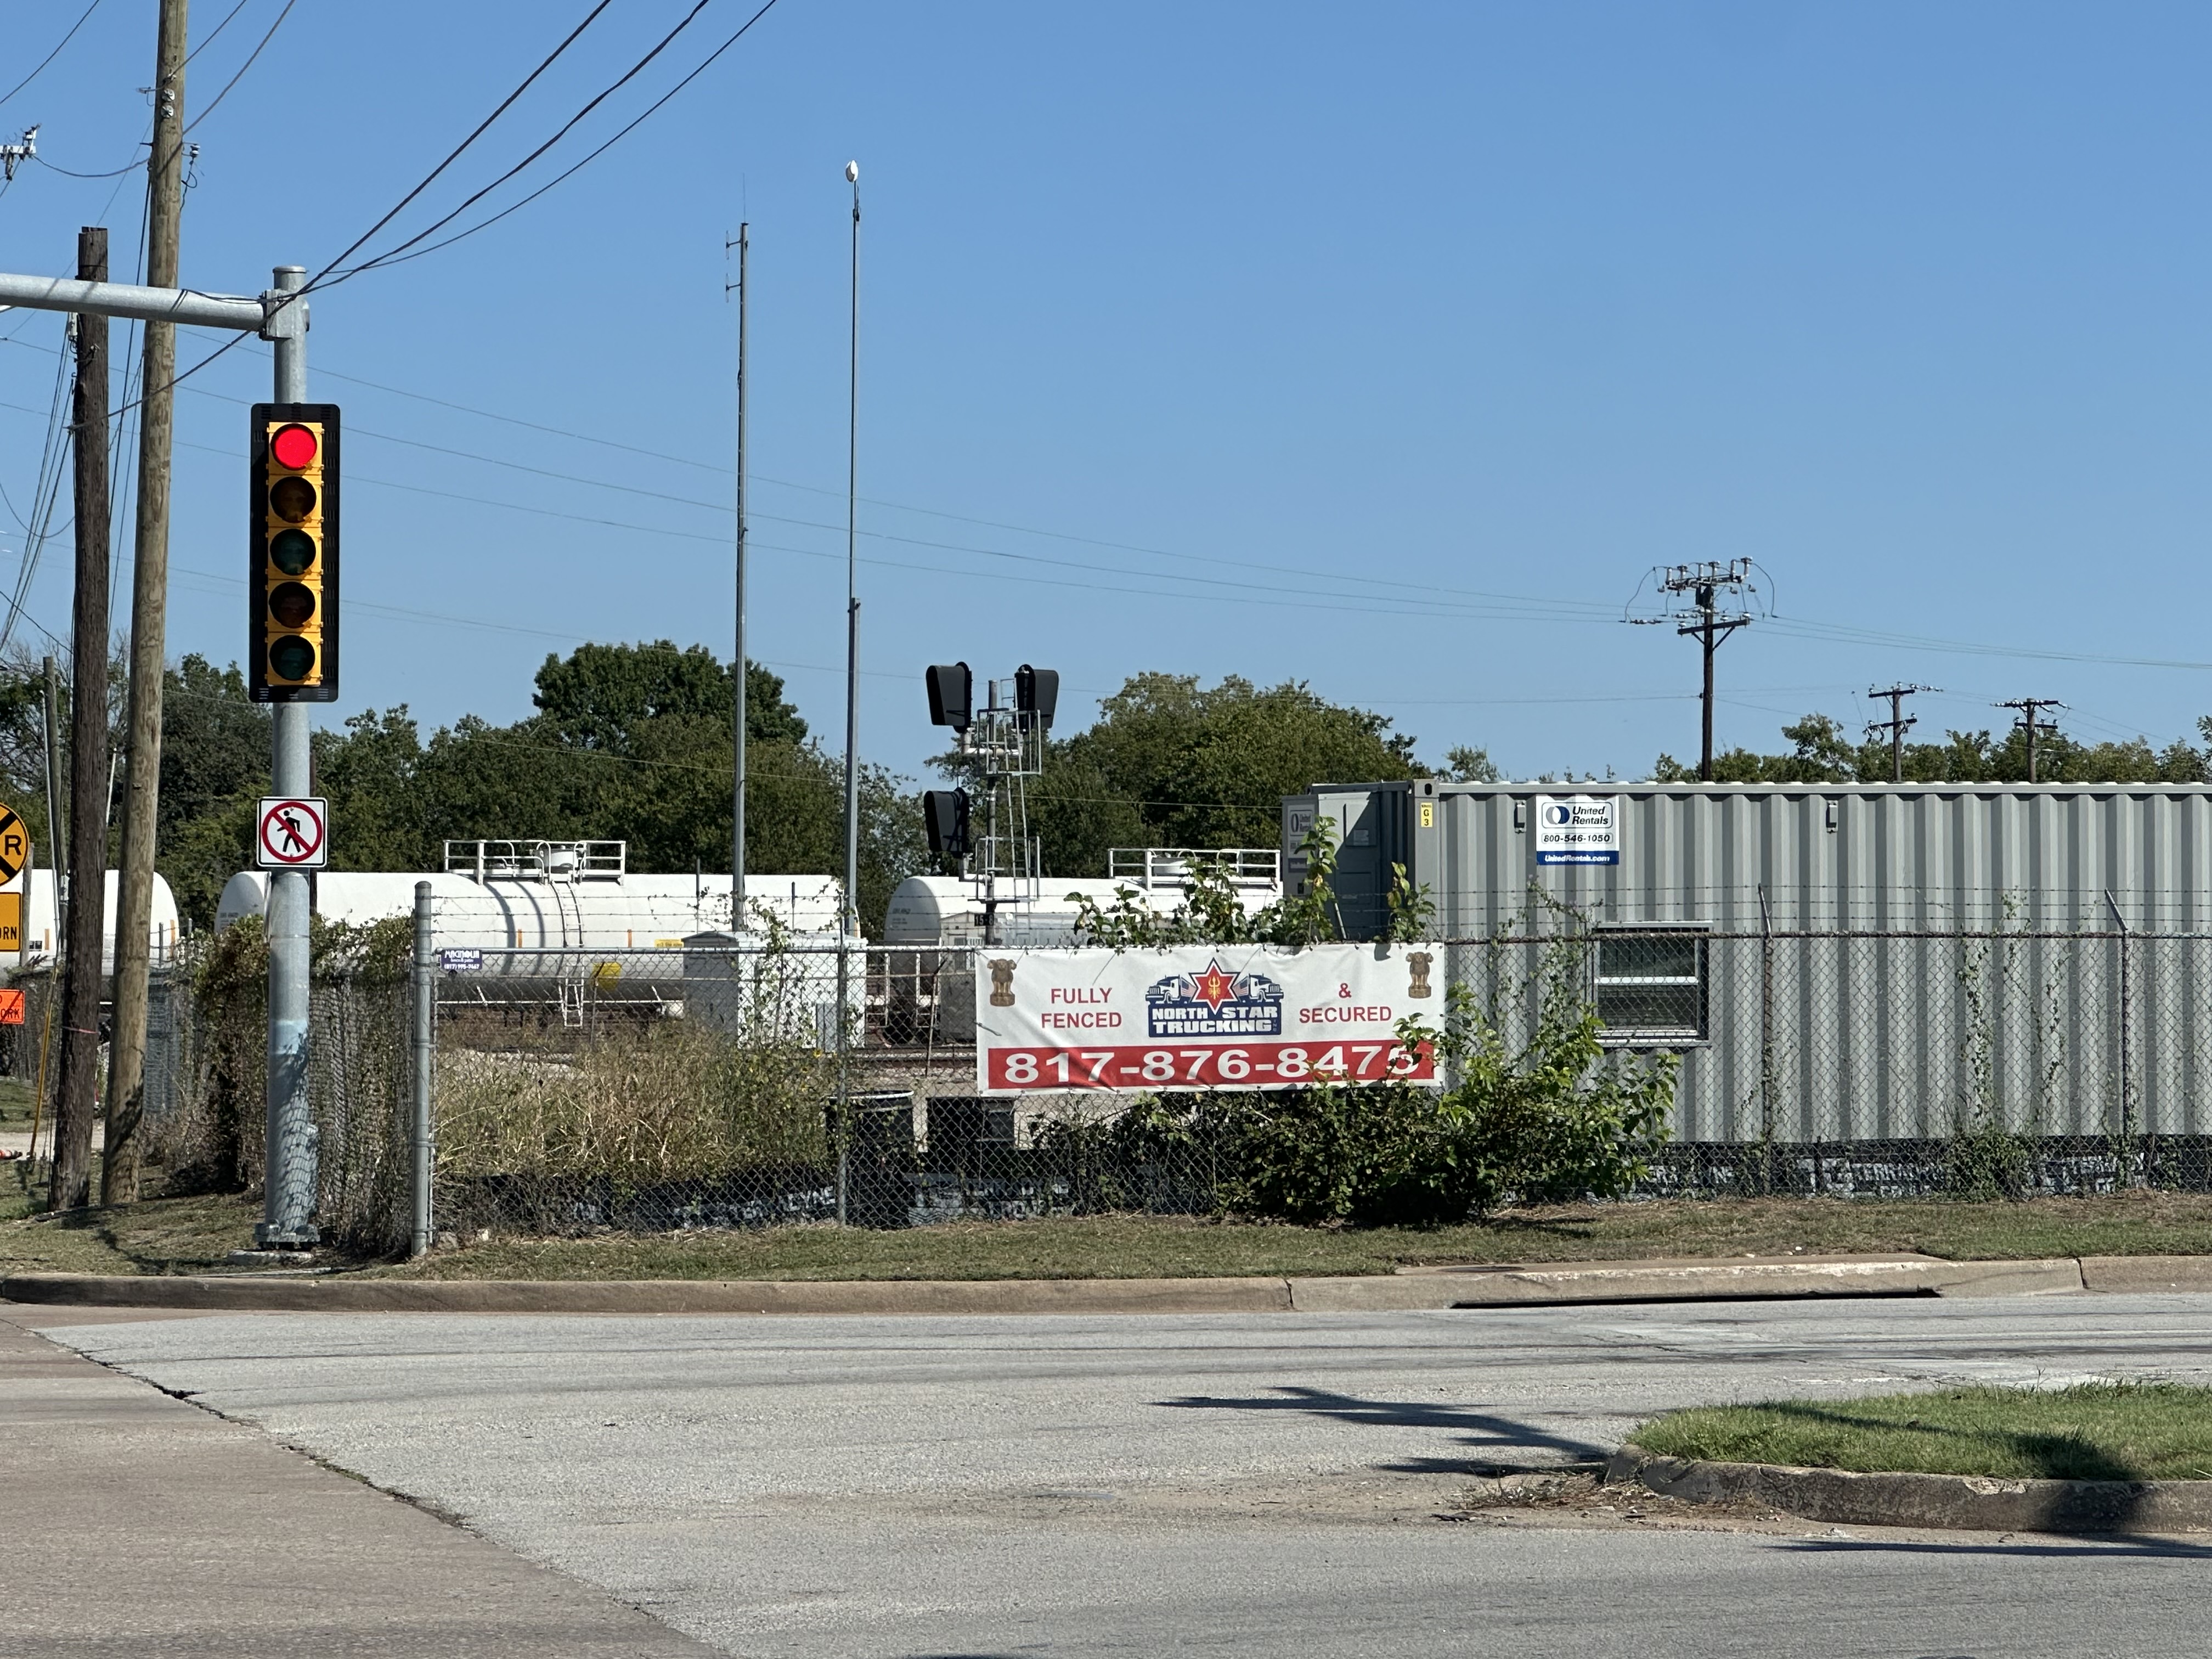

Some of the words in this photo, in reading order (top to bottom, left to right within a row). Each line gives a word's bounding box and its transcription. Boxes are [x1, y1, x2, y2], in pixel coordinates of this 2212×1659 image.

[1572, 806, 1606, 815] United
[1572, 816, 1609, 825] Rentals
[4, 834, 21, 856] R
[0, 926, 16, 940] RN
[1051, 988, 1113, 1004] FULLY
[1339, 983, 1352, 998] &
[1042, 1012, 1122, 1029] FENCED
[1153, 1007, 1208, 1020] NORTH
[1222, 1006, 1277, 1019] STAR
[1299, 1006, 1392, 1023] SECURED
[1153, 1019, 1272, 1034] TRUCKING
[1005, 1046, 1419, 1084] 817-876-8475
